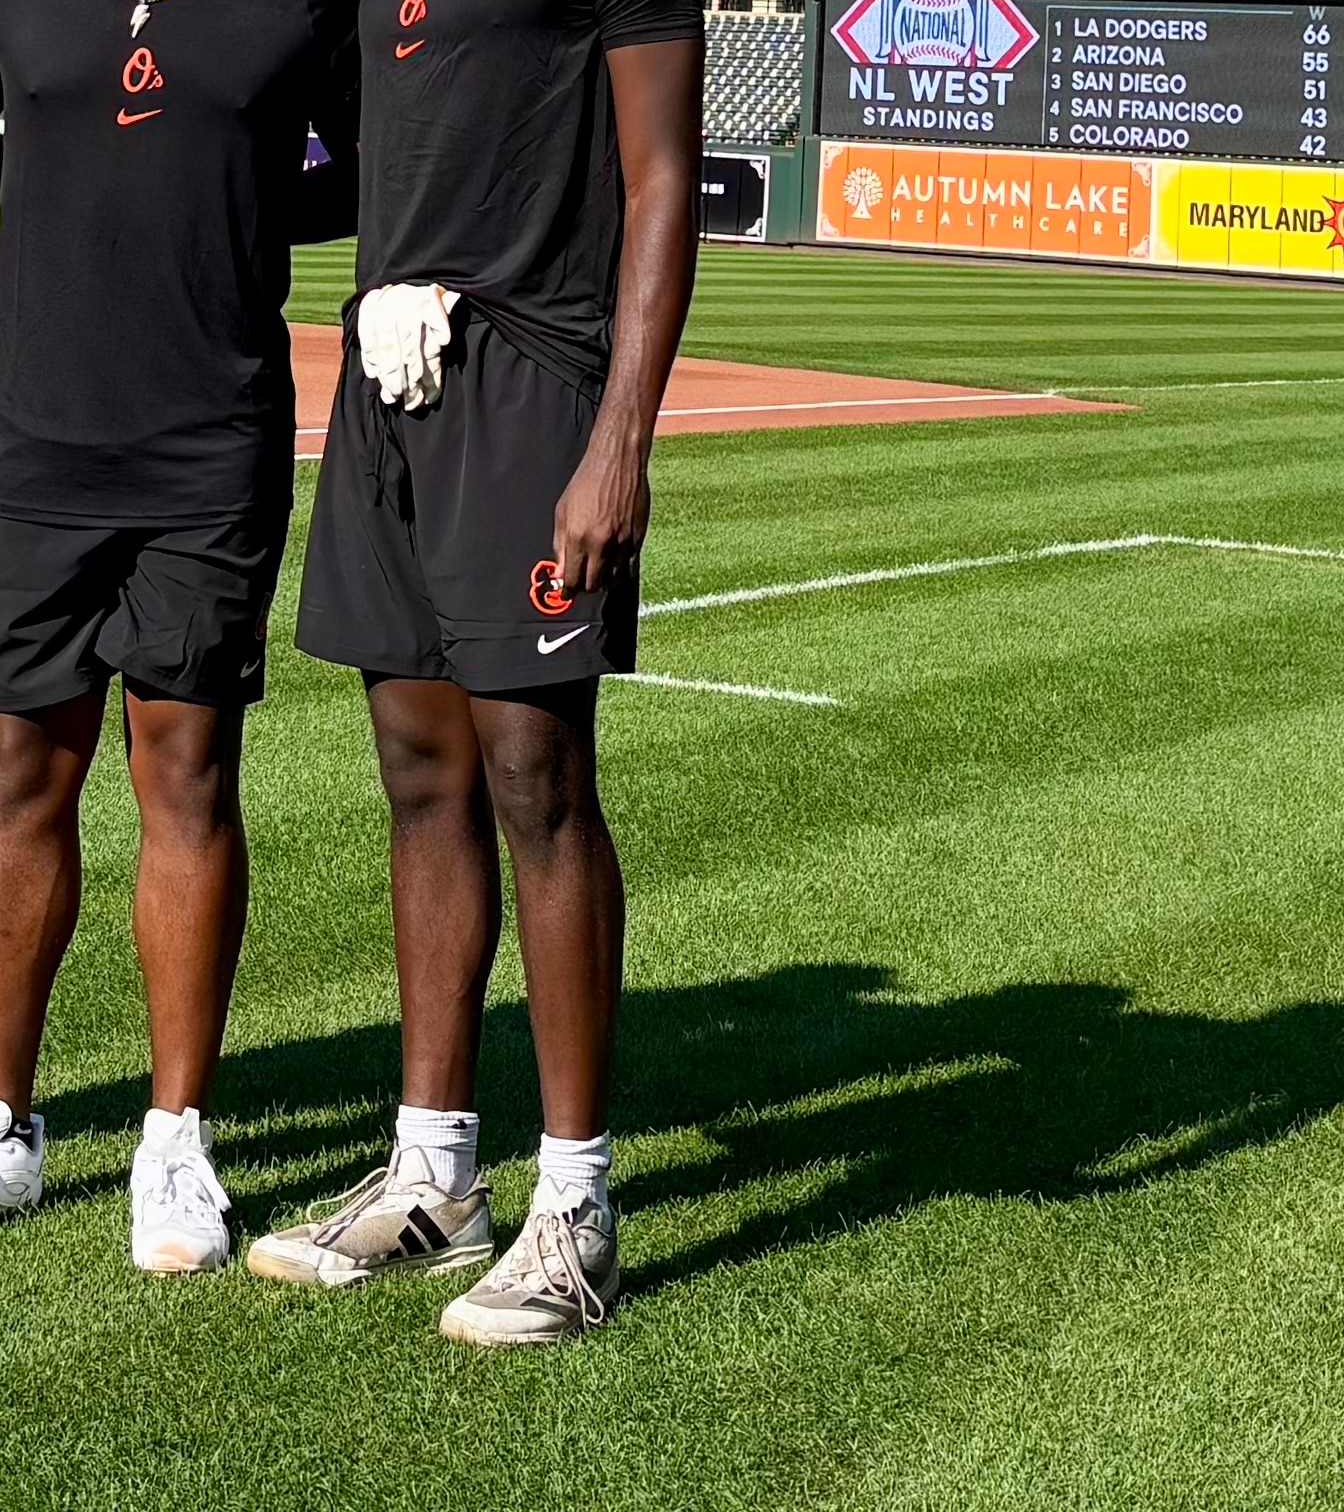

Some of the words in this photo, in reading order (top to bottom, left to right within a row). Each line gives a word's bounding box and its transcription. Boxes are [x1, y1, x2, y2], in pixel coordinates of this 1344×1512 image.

[900, 9, 966, 47] NATIONAL
[1054, 20, 1062, 37] 1
[1074, 17, 1100, 38] LA
[1105, 19, 1208, 41] DODGERS
[1303, 23, 1331, 45] 66
[1051, 47, 1062, 63] 2
[1072, 44, 1166, 67] ARIZONA
[1302, 51, 1329, 73] 55
[849, 66, 896, 101] NL
[908, 69, 1014, 106] WEST
[1051, 73, 1061, 90] 3
[1071, 70, 1114, 92] SAN
[1111, 72, 1187, 95] DIEGO
[1303, 79, 1326, 100] 51
[862, 103, 994, 131] STANDINGS
[1049, 100, 1060, 116] 4
[1070, 97, 1113, 119] SAN
[1118, 99, 1244, 124] FRANCISCO
[1300, 107, 1327, 128] 43
[1049, 126, 1059, 143] 5
[1069, 123, 1190, 151] COLORADO
[1299, 134, 1326, 156] 42
[892, 175, 1031, 207] AUTUMN
[1046, 182, 1129, 215] LAKE
[891, 208, 1128, 238] HEALTHCARE
[1189, 202, 1325, 233] MARYLAND
